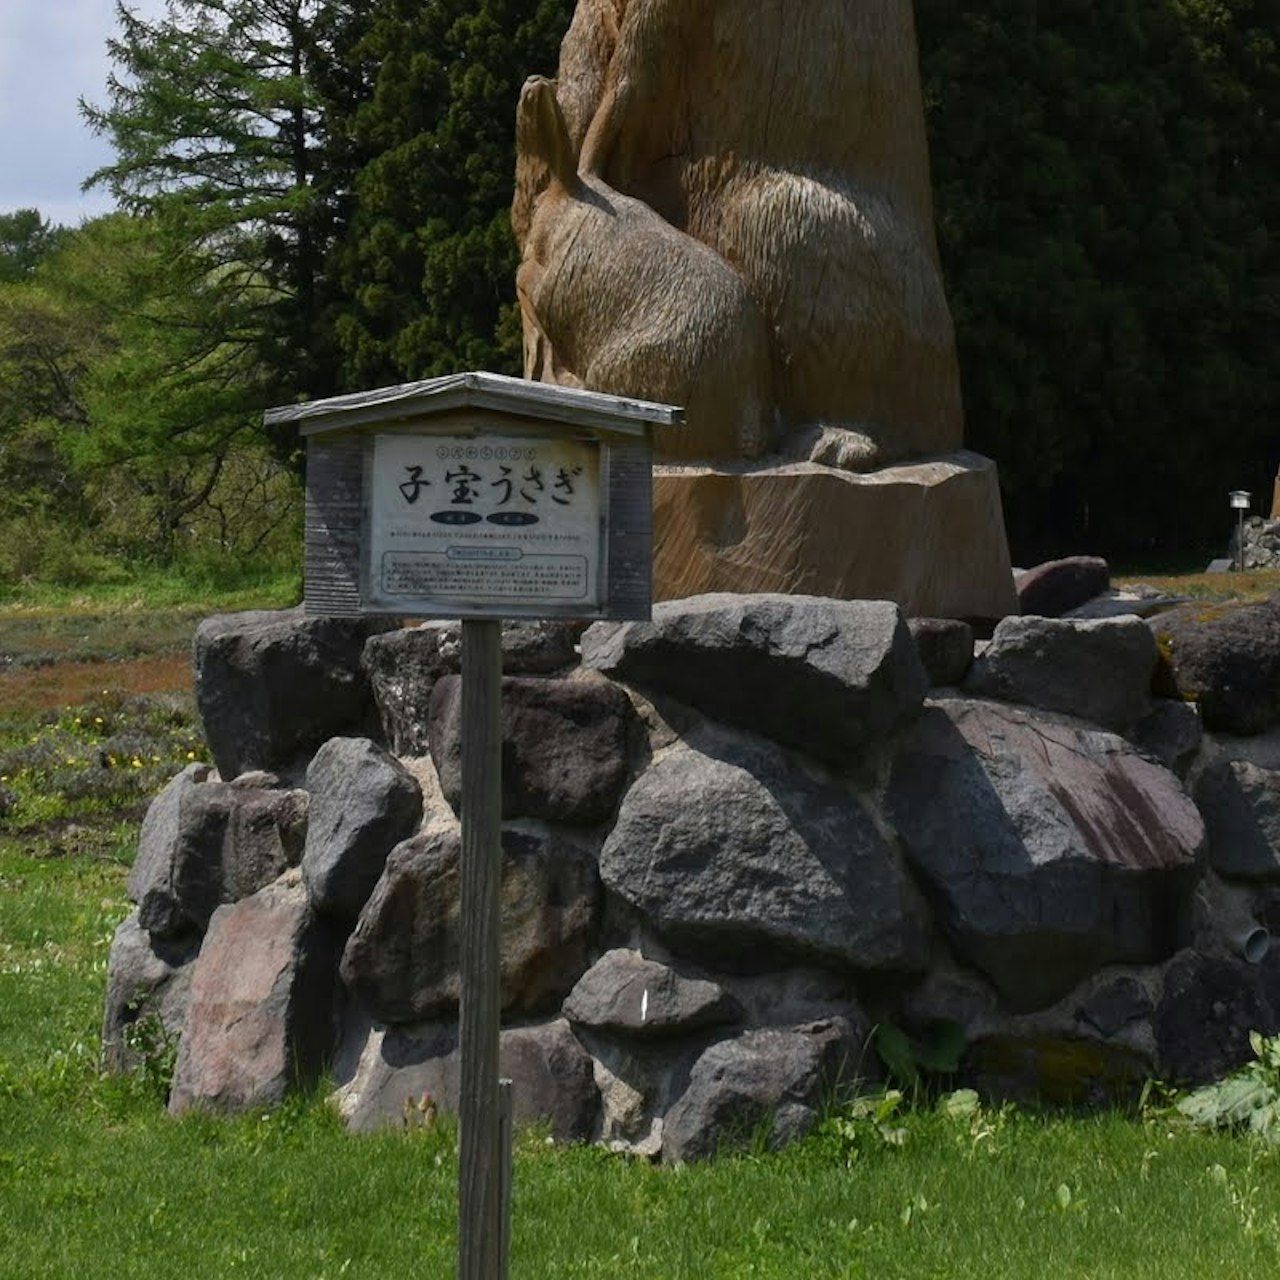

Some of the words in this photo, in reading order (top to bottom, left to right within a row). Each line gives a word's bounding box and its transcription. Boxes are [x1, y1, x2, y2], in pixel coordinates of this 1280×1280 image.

[399, 465, 582, 505] 子宝うさぎ
